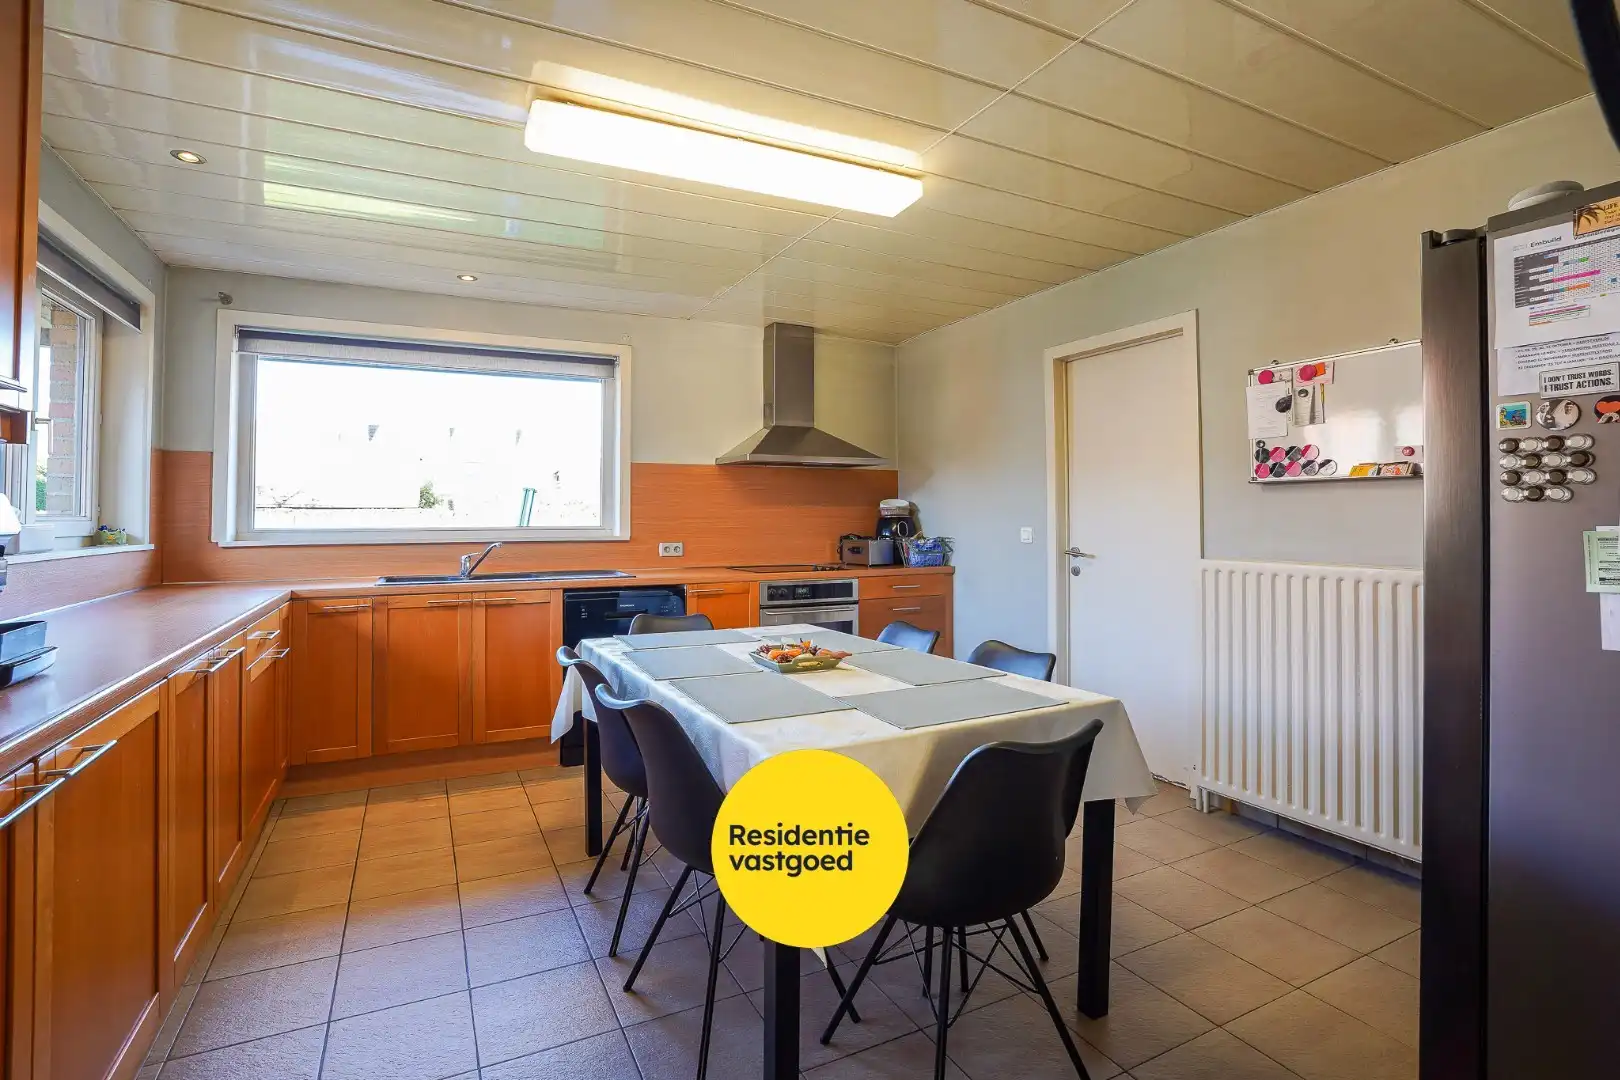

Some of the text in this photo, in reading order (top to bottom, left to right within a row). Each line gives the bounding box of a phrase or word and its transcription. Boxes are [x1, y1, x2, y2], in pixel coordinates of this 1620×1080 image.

[1530, 235, 1562, 248] Embuild
[1547, 374, 1566, 383] DON'T
[1567, 372, 1586, 381] TRUST
[1588, 369, 1614, 378] WORDS.
[1549, 382, 1574, 393] TRUST
[1576, 377, 1615, 389] ACTIONS.
